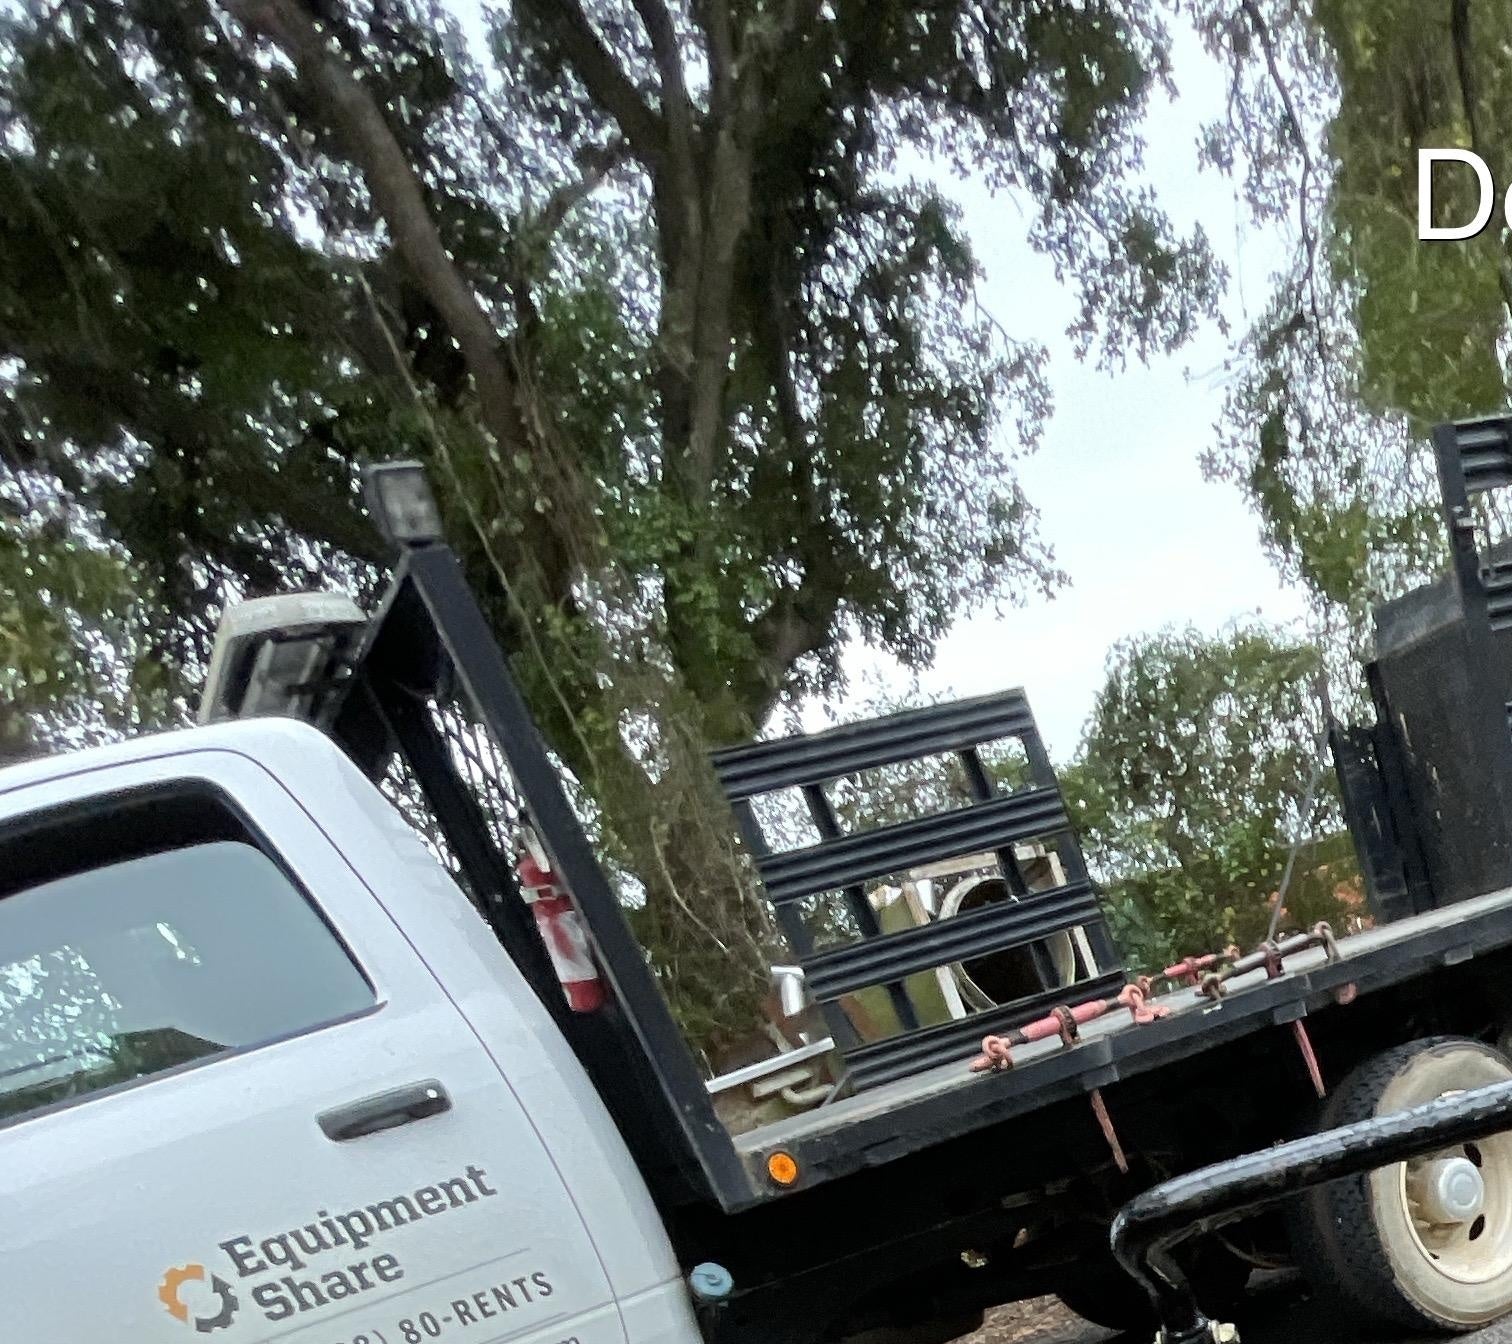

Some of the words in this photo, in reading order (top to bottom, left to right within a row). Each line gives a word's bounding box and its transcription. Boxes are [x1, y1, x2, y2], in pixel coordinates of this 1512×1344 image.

[218, 1165, 498, 1278] Equipment
[251, 1252, 405, 1321] Share
[398, 1271, 554, 1344] 80-RENTS
